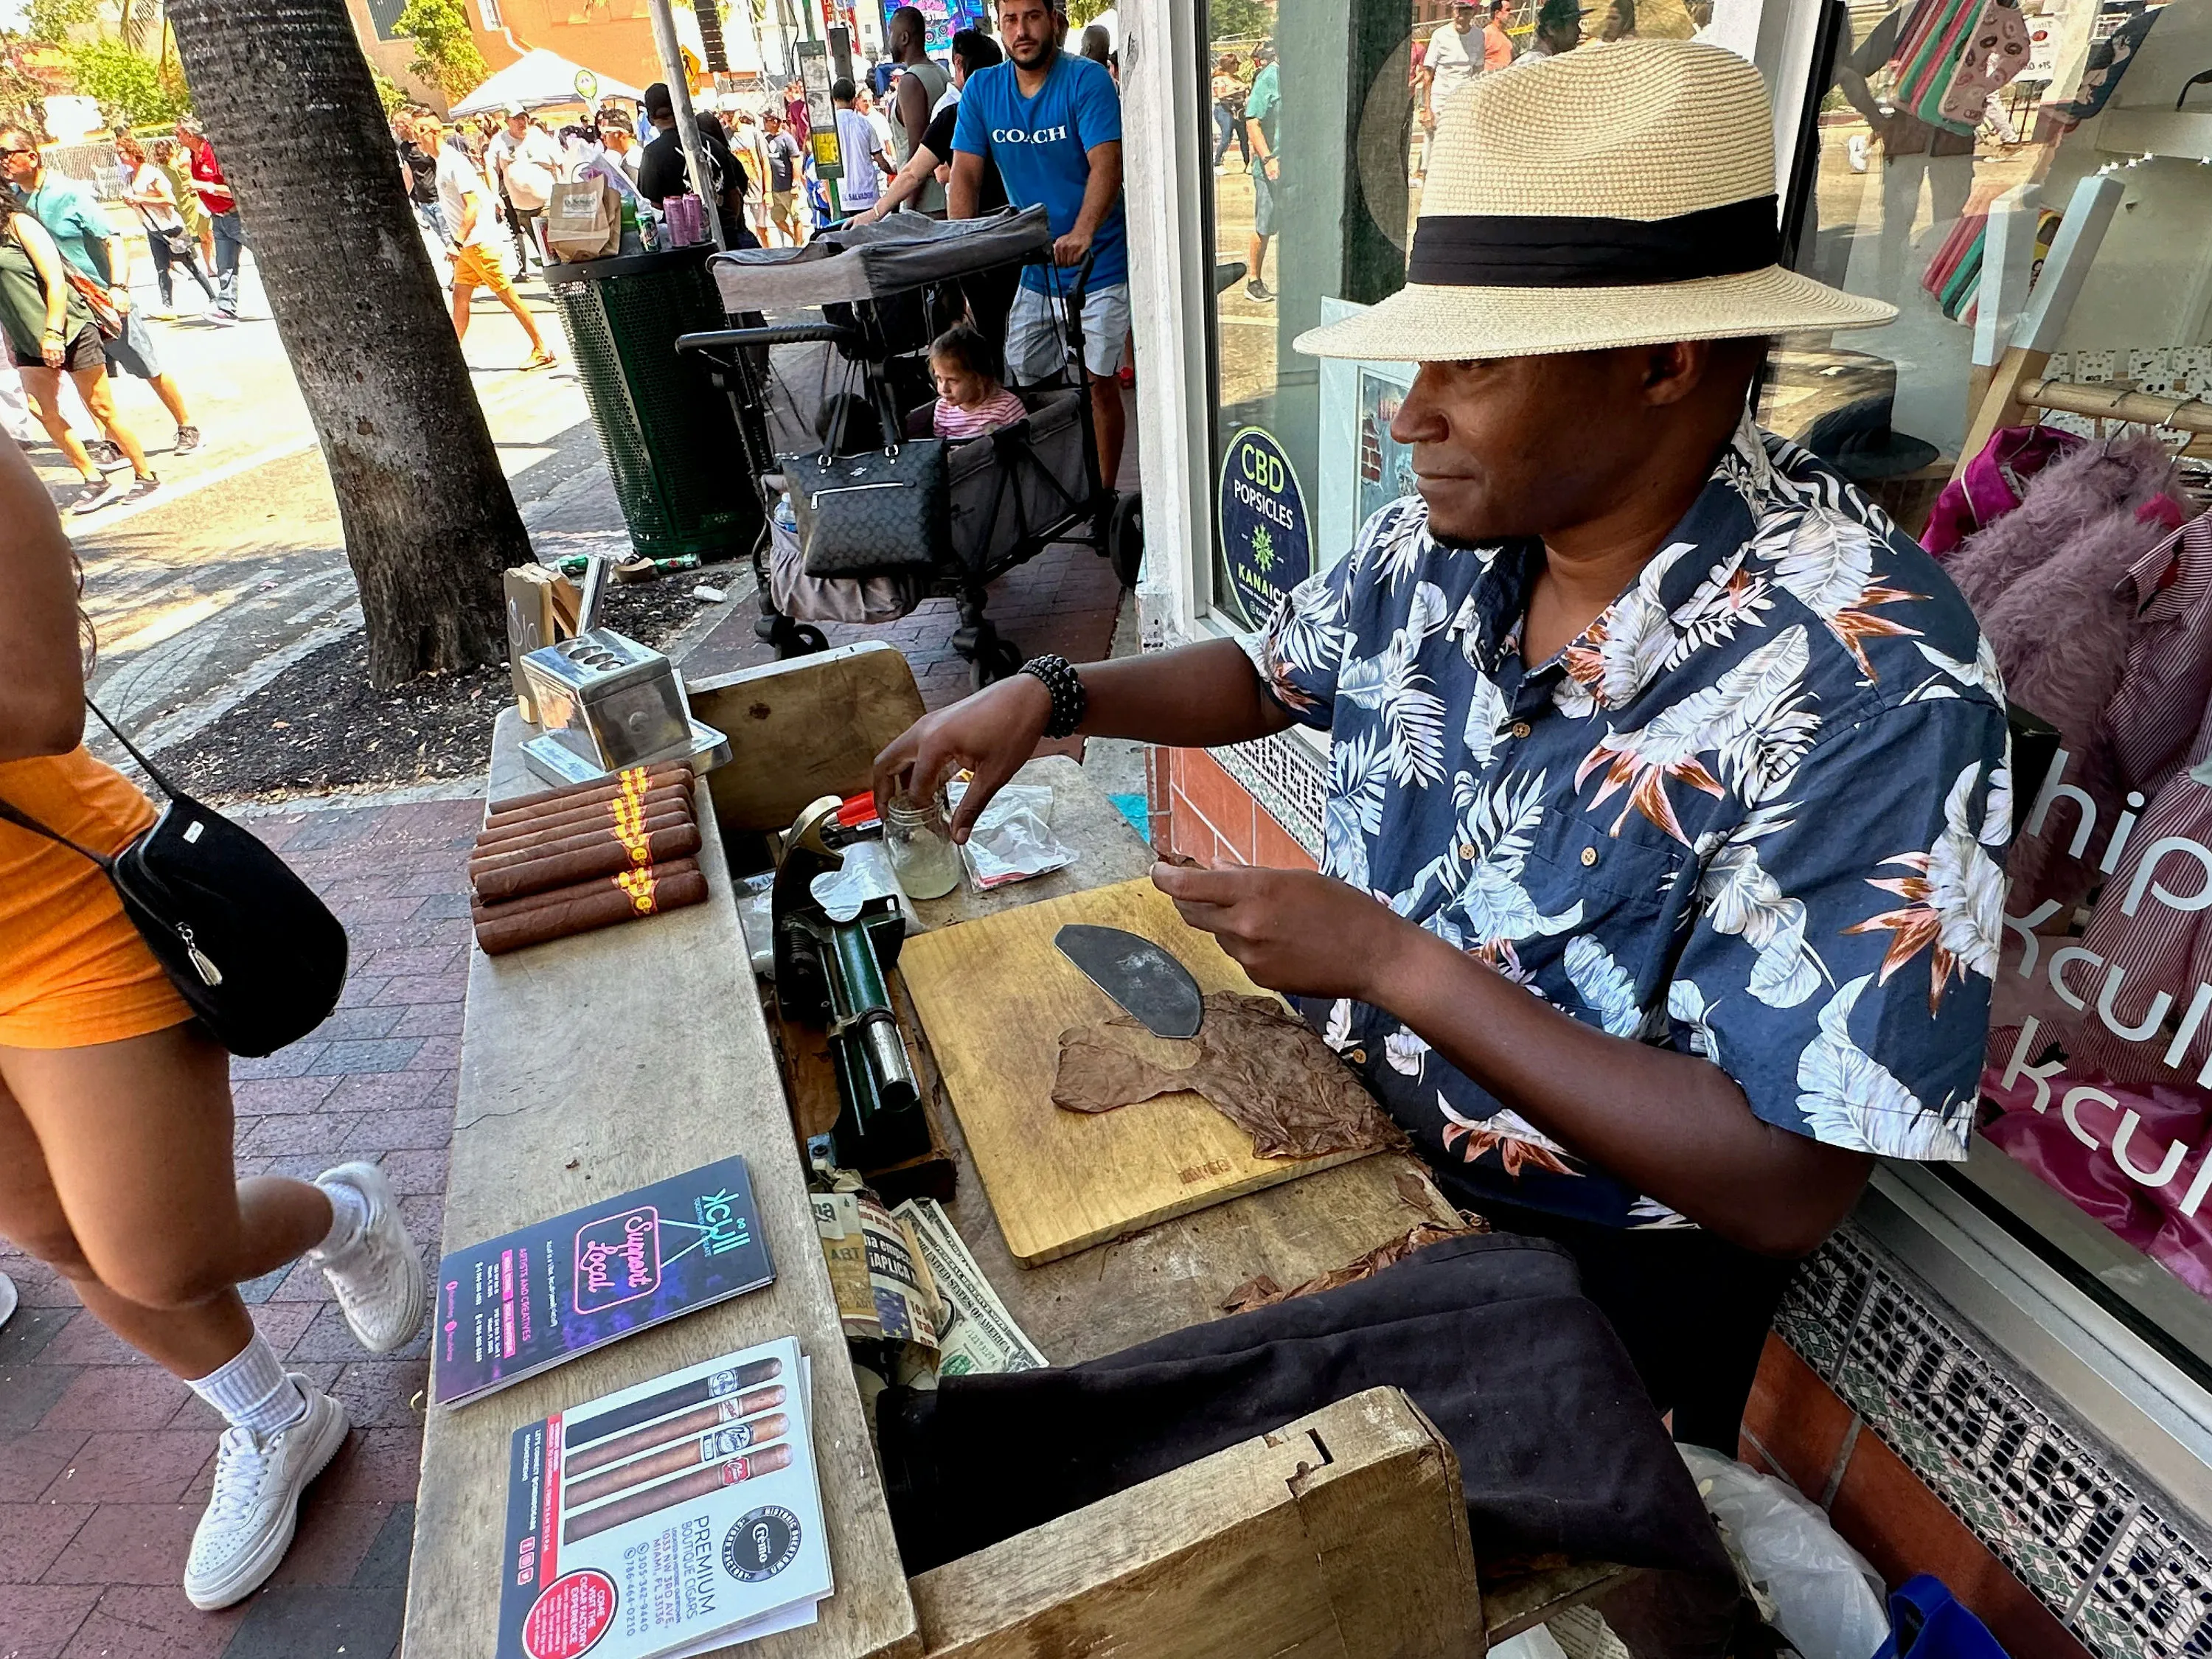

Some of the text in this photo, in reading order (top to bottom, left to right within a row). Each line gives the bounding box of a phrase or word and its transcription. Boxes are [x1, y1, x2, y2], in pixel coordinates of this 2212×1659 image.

[992, 125, 1067, 145] COACH
[1242, 443, 1284, 494] CBD
[1234, 479, 1293, 530] POPSICLES
[580, 1239, 617, 1293] Local
[617, 1214, 653, 1290] Support
[520, 1277, 529, 1296] AND
[924, 1251, 952, 1281] UNITED
[946, 1277, 975, 1310] STATES
[968, 1306, 985, 1322] OF
[978, 1317, 1012, 1354] AMERICA
[520, 1295, 531, 1342] CREATIVES
[661, 1528, 671, 1552] 1033
[765, 1509, 796, 1528] HISTORIC
[663, 1554, 671, 1573] NW
[751, 1520, 771, 1564] Cremo
[653, 1577, 662, 1593] FL
[664, 1575, 672, 1599] 3RD
[681, 1520, 697, 1620] BOUTIQUE CIGARS
[693, 1515, 715, 1615] PREMIUM
[569, 1585, 578, 1645] EXPERIENCE
[597, 1589, 605, 1618] COME
[654, 1593, 664, 1625] 33136
[578, 1604, 587, 1648] FACTORY
